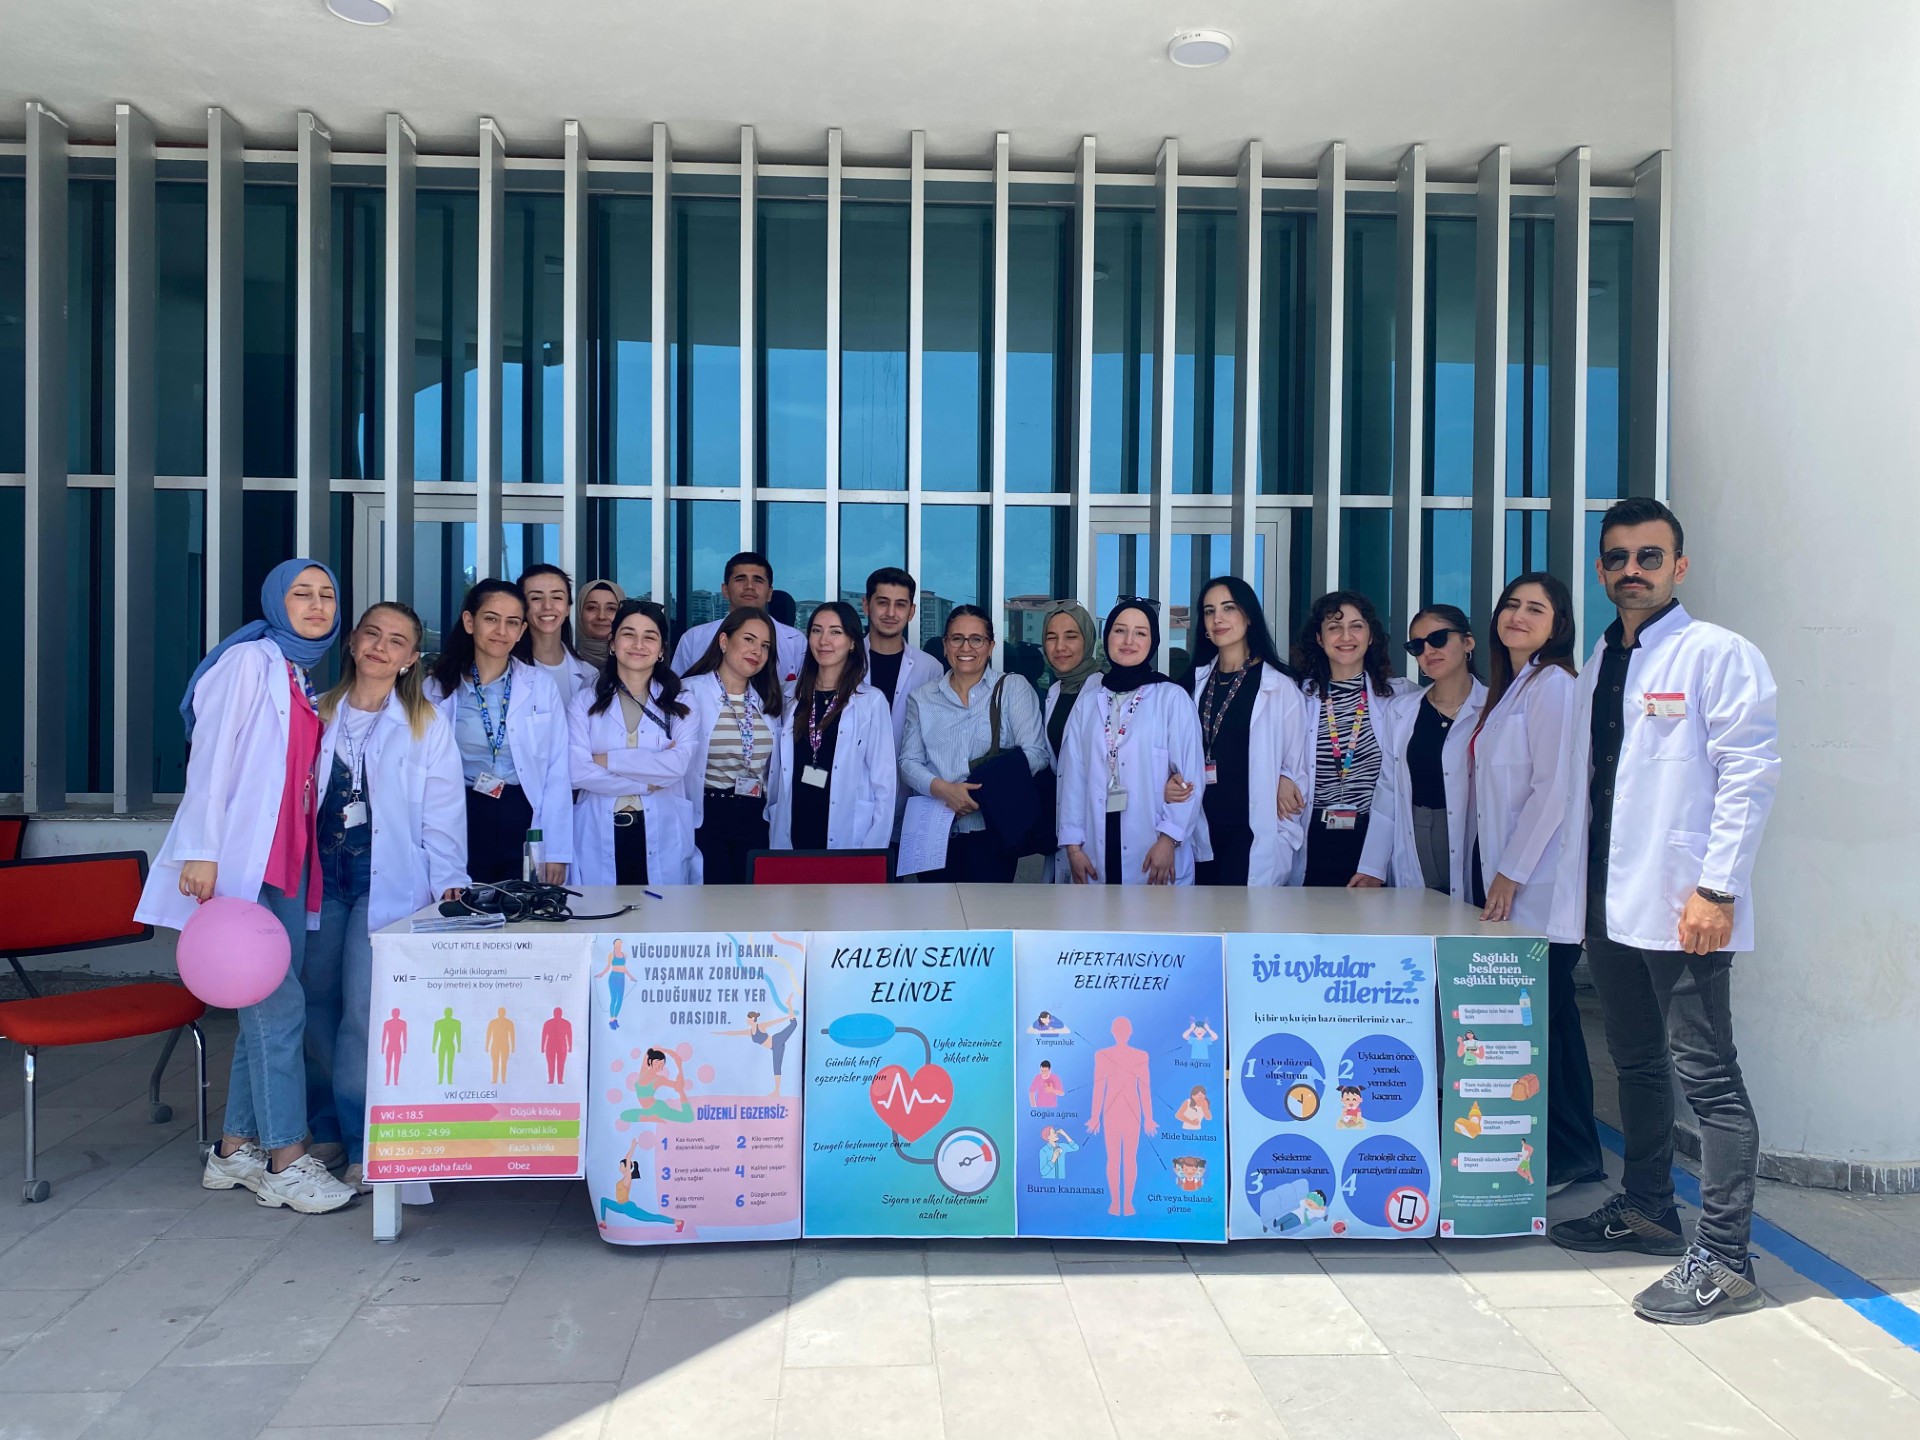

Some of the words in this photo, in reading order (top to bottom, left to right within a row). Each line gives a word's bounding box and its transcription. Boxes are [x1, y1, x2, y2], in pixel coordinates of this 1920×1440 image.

[514, 942, 532, 950] (VKİ)
[632, 943, 710, 958] VÜCUDUNUZA
[716, 942, 732, 958] İYİ
[738, 944, 778, 958] BAKIN.
[831, 944, 918, 969] KALBİN
[922, 943, 995, 967] SENİN
[1057, 948, 1186, 969] HİPERTANSİYON
[1472, 952, 1518, 964] Sağlıklı
[469, 968, 507, 976] (kilogram)
[1252, 953, 1281, 983] iyi
[1284, 954, 1376, 983] uykular
[1468, 964, 1522, 974] beslenen
[544, 974, 553, 982] kg
[645, 967, 704, 984] YAŞAMAK
[709, 967, 764, 980] ZORUNDA
[1454, 975, 1496, 987] sağlıklı
[1499, 975, 1536, 987] büyür
[1074, 973, 1171, 991] BELİRTİLERİ
[642, 986, 712, 1002] OLDUĞUNUZ
[718, 989, 738, 1002] TEK
[745, 989, 766, 1002] YER
[870, 978, 956, 1003] ELİNDE
[670, 1011, 731, 1024] ORASIDIR.
[1254, 1012, 1265, 1024] İyi
[1266, 1014, 1279, 1022] bir
[1280, 1014, 1300, 1024] uyku
[1301, 1014, 1316, 1024] için
[1318, 1014, 1335, 1022] bazı
[1337, 1015, 1389, 1024] önerilerimiz
[933, 1039, 955, 1054] Uyku
[957, 1038, 1002, 1048] düzeninize
[1036, 1039, 1074, 1047] Yorgunluk
[825, 1057, 856, 1067] Günlük
[859, 1056, 882, 1068] hafif
[943, 1053, 970, 1064] dikkat
[972, 1053, 989, 1063] edin
[1284, 1058, 1312, 1066] düzeni
[1358, 1051, 1394, 1061] Uykudan
[1396, 1052, 1414, 1061] önce
[1174, 1059, 1188, 1068] Baş
[1244, 1058, 1257, 1078] 1
[1338, 1059, 1354, 1079] 2
[1372, 1065, 1400, 1075] yemek
[815, 1072, 861, 1086] egzersizler
[861, 1074, 887, 1085] yapın
[1367, 1079, 1406, 1088] yemekten
[445, 1090, 457, 1099] VKİ
[460, 1090, 498, 1101] ÇİZELGESİ
[1372, 1092, 1402, 1102] kaçının.
[381, 1110, 394, 1120] VKİ
[406, 1110, 424, 1120] 18.5
[510, 1107, 536, 1117] Düşük
[539, 1107, 561, 1116] kilolu
[697, 1104, 737, 1120] DÜZENLİ
[740, 1104, 788, 1119] EGZERSİZ:
[380, 1128, 394, 1138] VKİ
[397, 1129, 420, 1138] 18.50
[427, 1128, 450, 1137] 24.99
[510, 1126, 540, 1134] Normal
[542, 1126, 557, 1134] kilo
[737, 1135, 746, 1148] 2
[1182, 1133, 1217, 1141] bulantısı
[509, 1144, 530, 1152] Fazla
[531, 1143, 554, 1152] kilolu
[661, 1138, 668, 1150] 1
[813, 1141, 843, 1153] Dengeli
[845, 1140, 888, 1151] beslenmeye
[379, 1147, 393, 1156] VKİ
[395, 1146, 414, 1156] 25.0
[421, 1146, 444, 1155] 29.99
[844, 1154, 876, 1166] gösterin
[1358, 1153, 1396, 1162] Teknolojik
[1397, 1153, 1416, 1162] cihaz
[378, 1164, 392, 1174] VKİ
[394, 1164, 405, 1173] 30
[406, 1166, 427, 1175] veya
[429, 1163, 450, 1172] daha
[452, 1162, 472, 1171] fazla
[508, 1162, 530, 1170] Obez
[735, 1165, 744, 1178] 4
[1256, 1167, 1300, 1176] yapmaktan
[1301, 1167, 1329, 1175] sakının.
[1352, 1167, 1397, 1176] maruziyetini
[1398, 1167, 1423, 1175] azaltın
[662, 1167, 670, 1180] 3
[1247, 1171, 1264, 1194] 3
[1341, 1173, 1357, 1196] 4
[1027, 1185, 1056, 1193] Burun
[1059, 1185, 1104, 1194] kanaması
[661, 1194, 669, 1207] 5
[736, 1194, 744, 1207] 6
[882, 1194, 910, 1208] Sigara
[912, 1196, 921, 1204] ve
[923, 1195, 943, 1205] alkol
[945, 1195, 989, 1205] tüketimini
[1148, 1194, 1162, 1202] Çift
[919, 1209, 948, 1220] azaltın
[1167, 1206, 1192, 1214] görme
